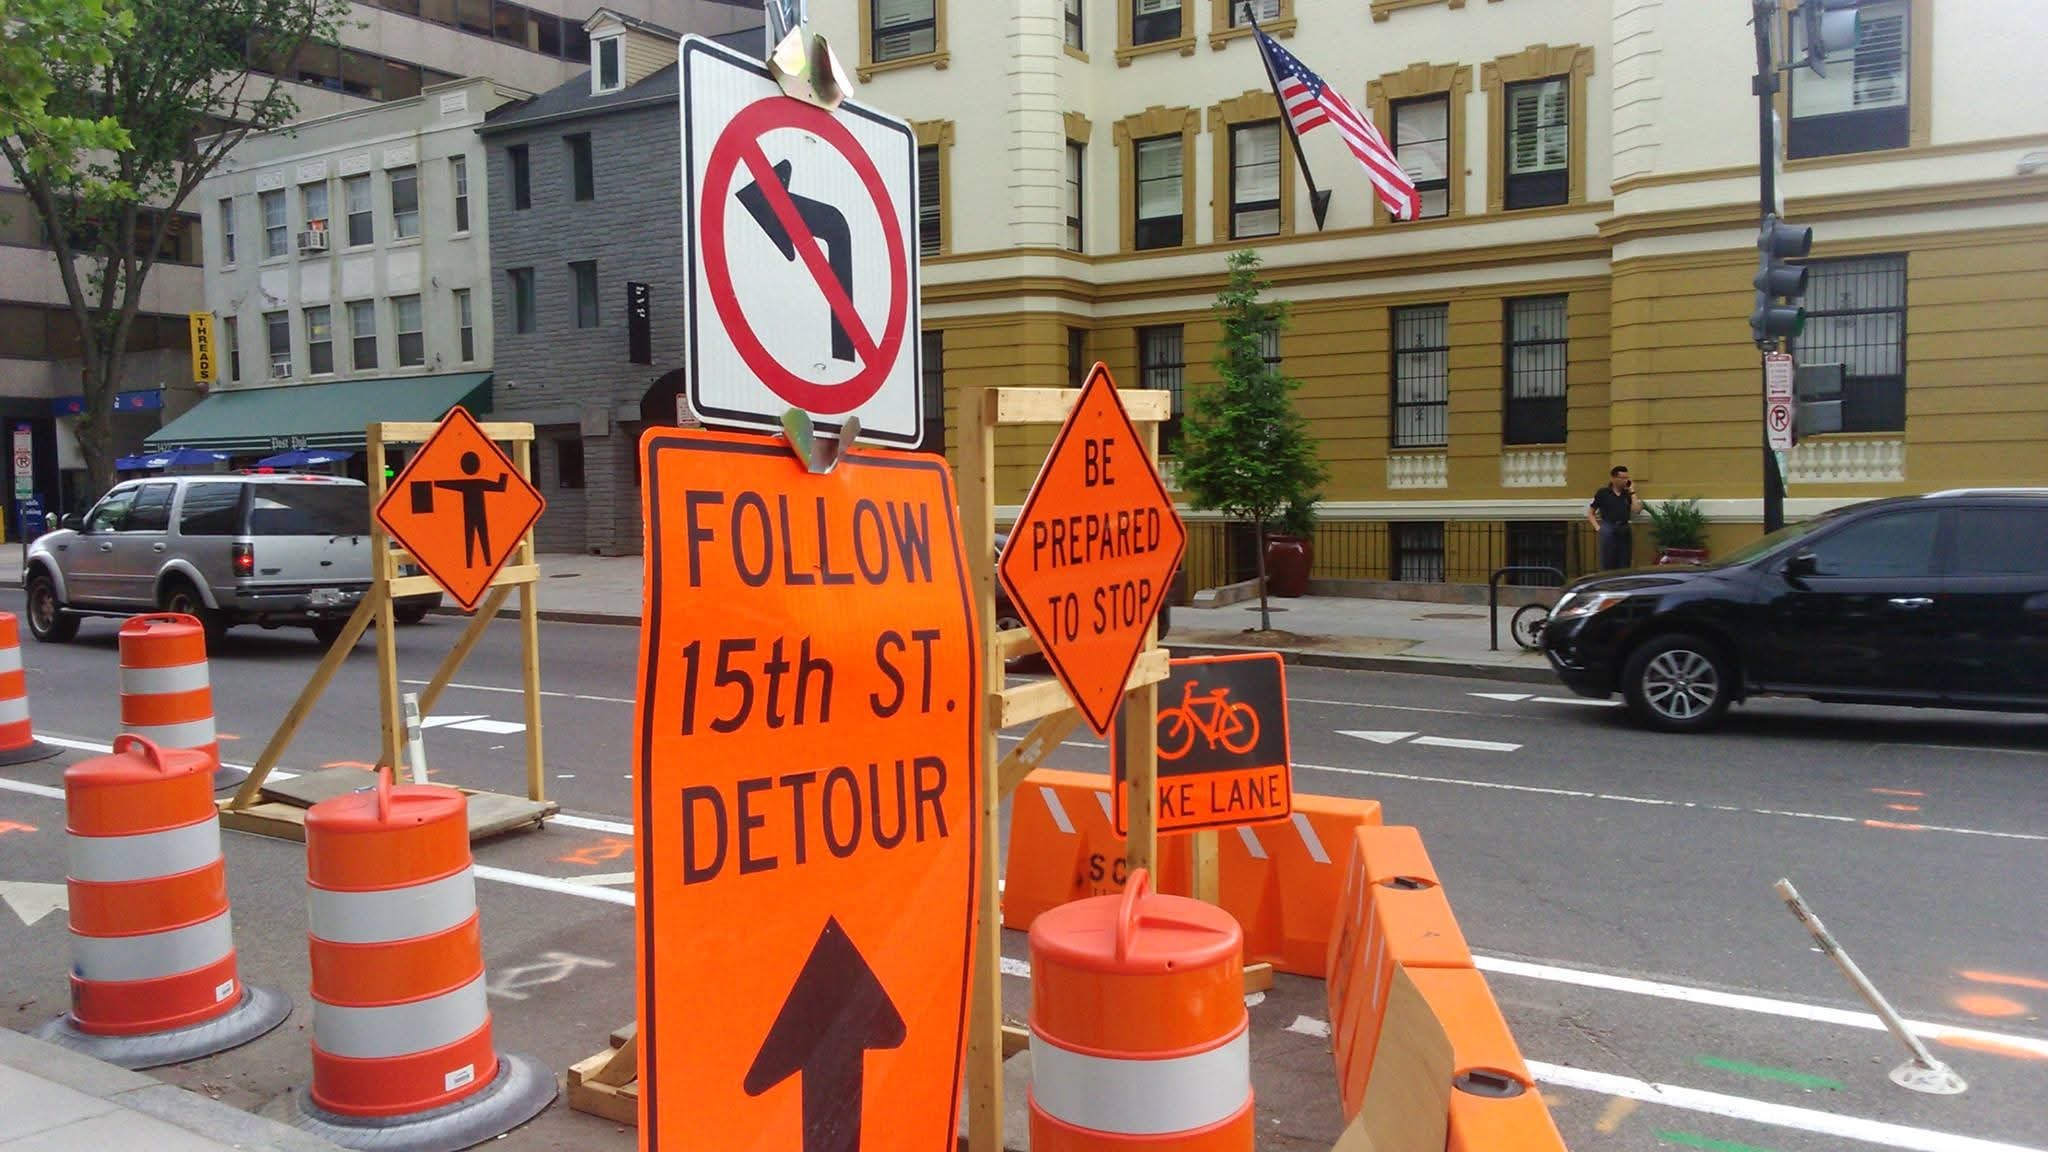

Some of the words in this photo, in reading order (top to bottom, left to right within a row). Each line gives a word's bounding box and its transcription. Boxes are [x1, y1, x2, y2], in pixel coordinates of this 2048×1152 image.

[197, 317, 208, 379] THREADS
[1085, 438, 1115, 487] BE
[685, 490, 933, 588] FOLLOW
[1033, 507, 1160, 572] PREPARED
[1048, 592, 1079, 646] TO
[1094, 579, 1151, 635] STOP
[681, 634, 834, 737] 15th
[869, 629, 956, 718] ST.
[681, 755, 949, 886] DETOUR
[1159, 784, 1195, 818] KE
[1211, 774, 1281, 814] LANE
